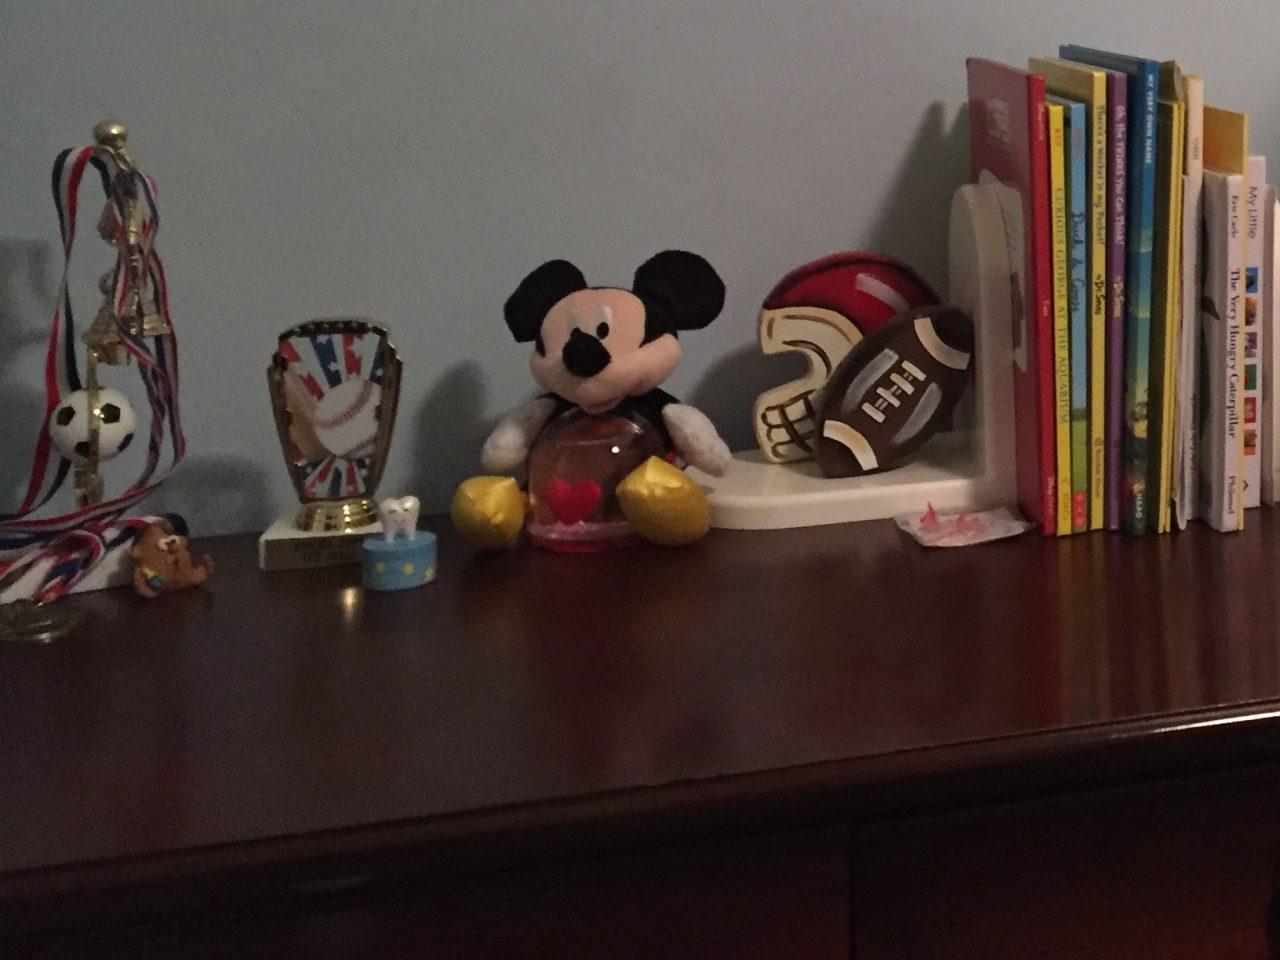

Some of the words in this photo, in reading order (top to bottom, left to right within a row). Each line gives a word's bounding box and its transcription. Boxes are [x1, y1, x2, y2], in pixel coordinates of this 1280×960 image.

[1246, 186, 1258, 206] My
[1055, 187, 1065, 245] CURIOUS
[1248, 209, 1258, 239] Little
[1056, 249, 1067, 299] GEORGE
[1230, 268, 1241, 291] The
[1227, 295, 1240, 321] Very
[1227, 325, 1240, 371] Hungry
[1226, 374, 1240, 438] Caterpillar
